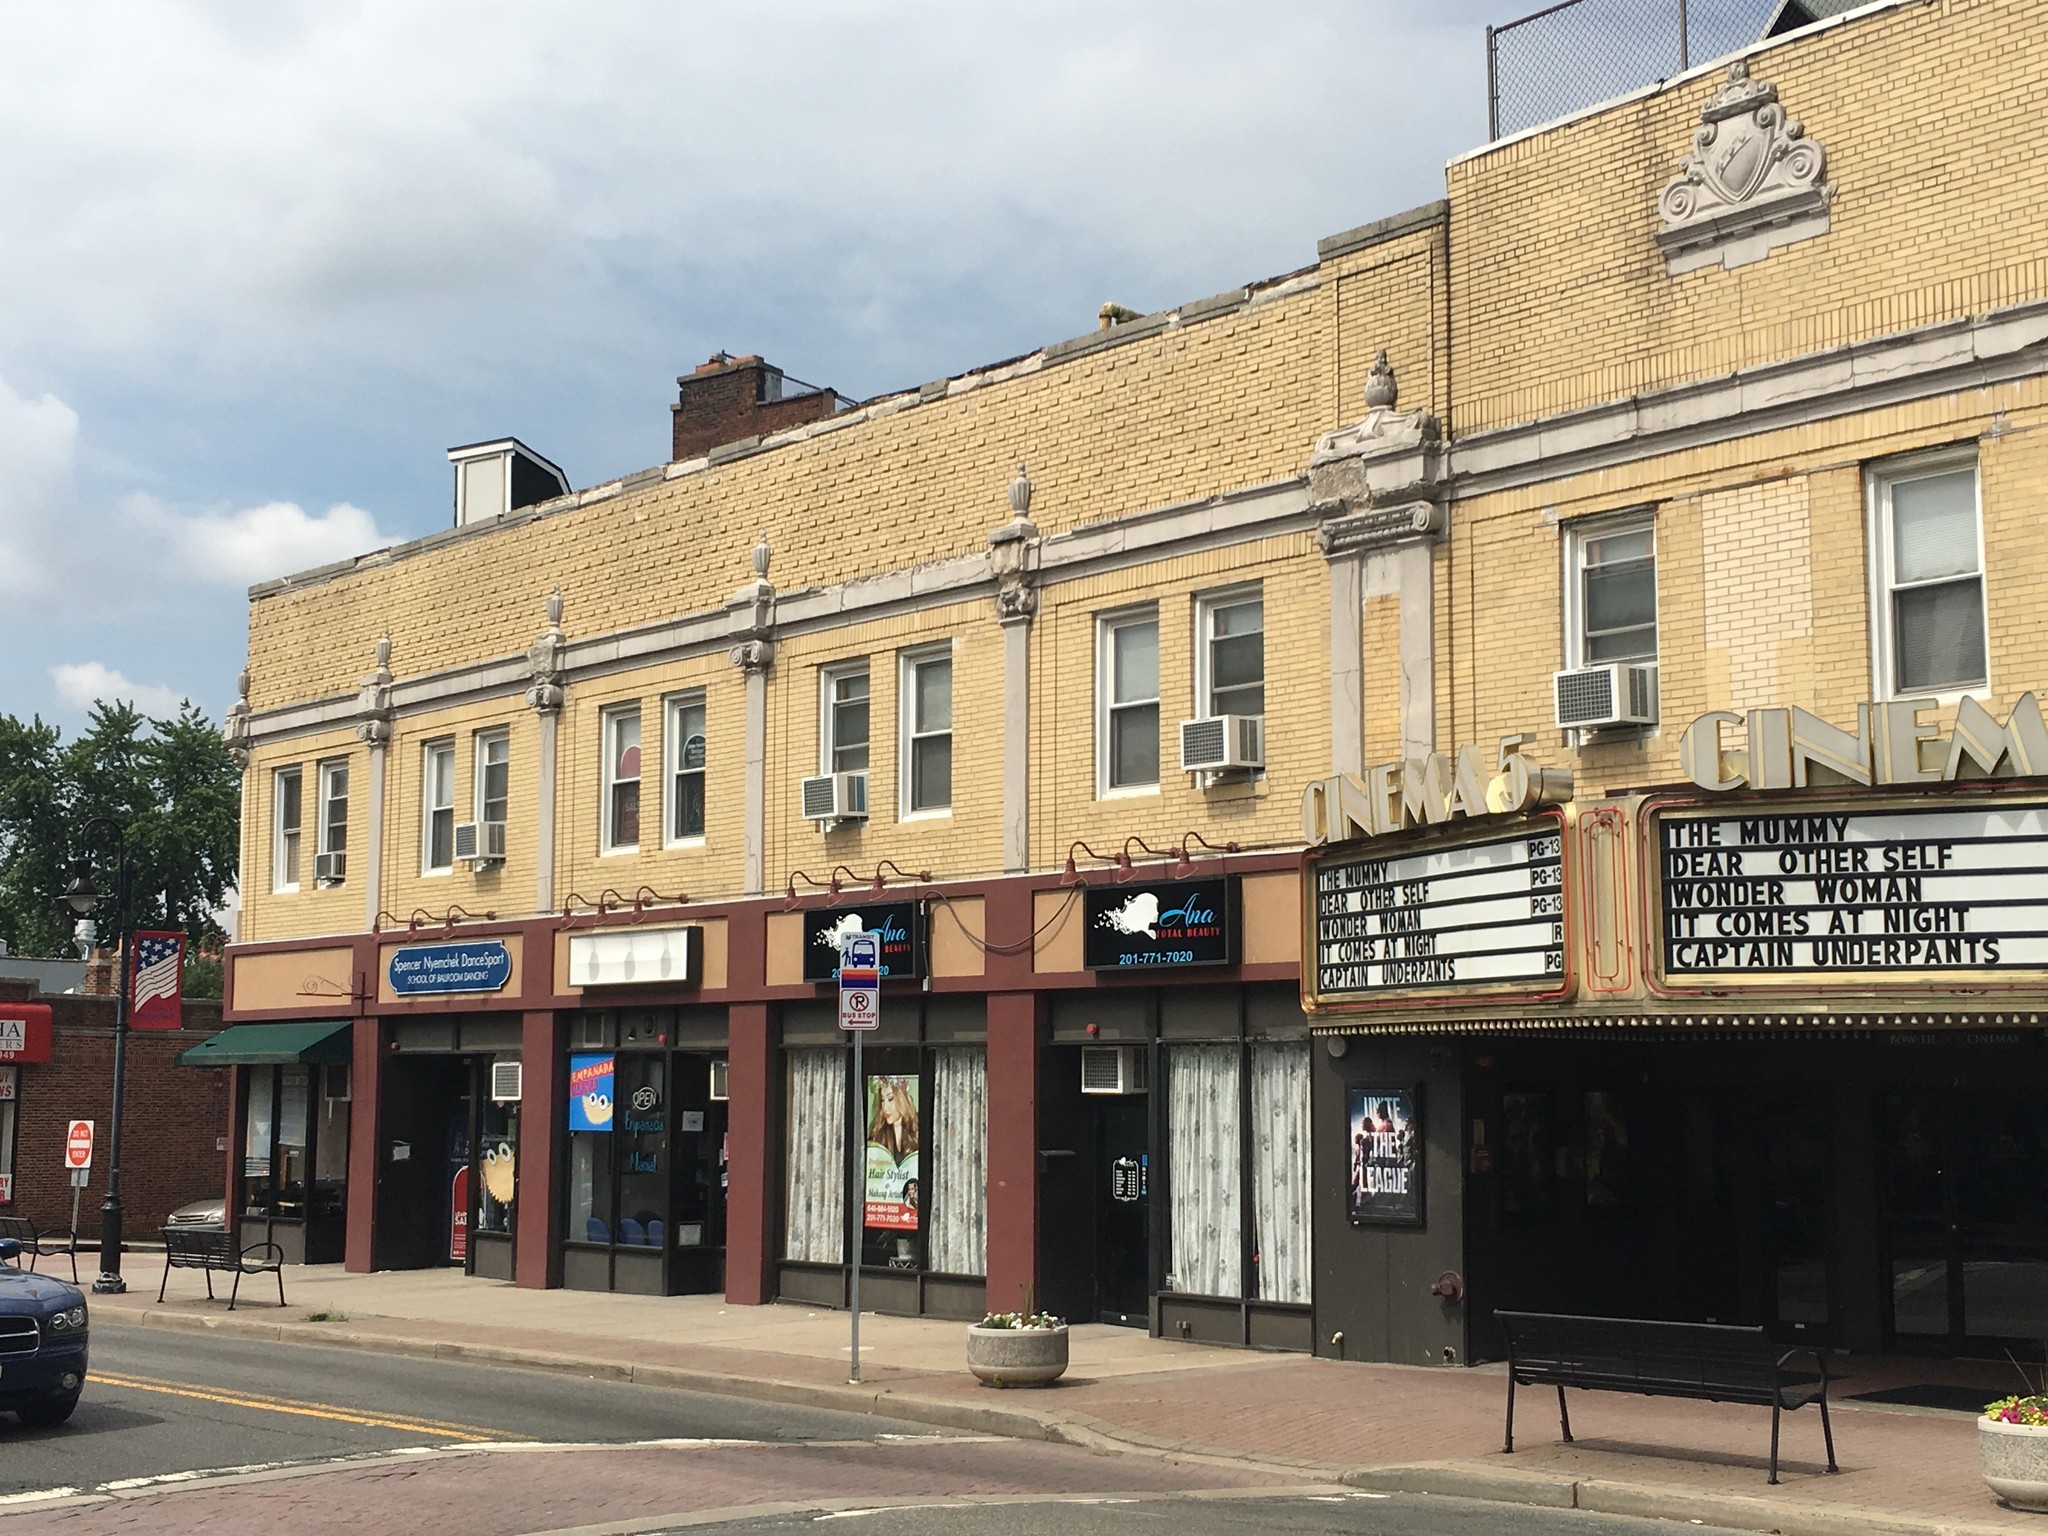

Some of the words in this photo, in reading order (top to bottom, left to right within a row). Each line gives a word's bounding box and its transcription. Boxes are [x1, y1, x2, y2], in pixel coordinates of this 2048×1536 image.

[1301, 744, 1490, 846] CINEMA
[1497, 732, 1534, 812] 5
[1671, 822, 1720, 847] THE
[1740, 817, 1849, 844] MUMMY
[1321, 870, 1340, 890] THE
[1345, 862, 1388, 888] MUMMY
[1529, 838, 1561, 857] PG-13
[1673, 852, 1743, 877] DEAR
[1779, 848, 1868, 874] OTHER
[1883, 845, 1952, 871] SELF
[1321, 893, 1348, 914] DEAR
[1360, 887, 1396, 910] OTHER
[1402, 881, 1429, 905] SELF
[1532, 866, 1562, 885] PG-13
[1672, 881, 1785, 907] WONDER
[1815, 876, 1922, 903] WOMAN
[1159, 893, 1217, 927] Ana
[1321, 916, 1367, 939] WONDER
[1380, 909, 1421, 934] WOMAN
[1532, 895, 1563, 914] PG-13
[1672, 912, 1699, 937] IT
[1716, 910, 1809, 936] COMES
[1828, 910, 1863, 934] AT
[1883, 907, 1969, 933] NIGHT
[869, 914, 908, 943] Ana
[1156, 928, 1182, 938] TOTAL
[1187, 927, 1220, 937] BEAUTY
[884, 944, 910, 953] BEAUTY
[1120, 951, 1193, 965] 201-771-7020
[1320, 944, 1332, 963] IT
[1338, 940, 1376, 962] COMES
[1383, 937, 1398, 959] AT
[1404, 933, 1437, 957] NIGHT
[1555, 925, 1562, 940] R
[1676, 941, 1793, 967] CAPTAIN
[1812, 938, 2000, 966] UNDERPANTS
[394, 958, 421, 974] Spencer
[424, 953, 459, 972] Nyemchek
[462, 951, 505, 968] DanceSport
[1321, 965, 1368, 989] CAPTAIN
[1382, 958, 1455, 984] UNDERPANTS
[1547, 954, 1561, 970] PG
[407, 975, 428, 984] SCHOOL
[429, 974, 436, 983] OF
[572, 1060, 614, 1082] EMPANADA
[633, 1091, 657, 1105] OPEN
[73, 1130, 80, 1138] DO
[80, 1130, 89, 1138] NOT
[1371, 1131, 1396, 1158] THE
[869, 1168, 885, 1179] Hair
[886, 1169, 910, 1183] Stylist
[1359, 1165, 1408, 1194] LEAGUE
